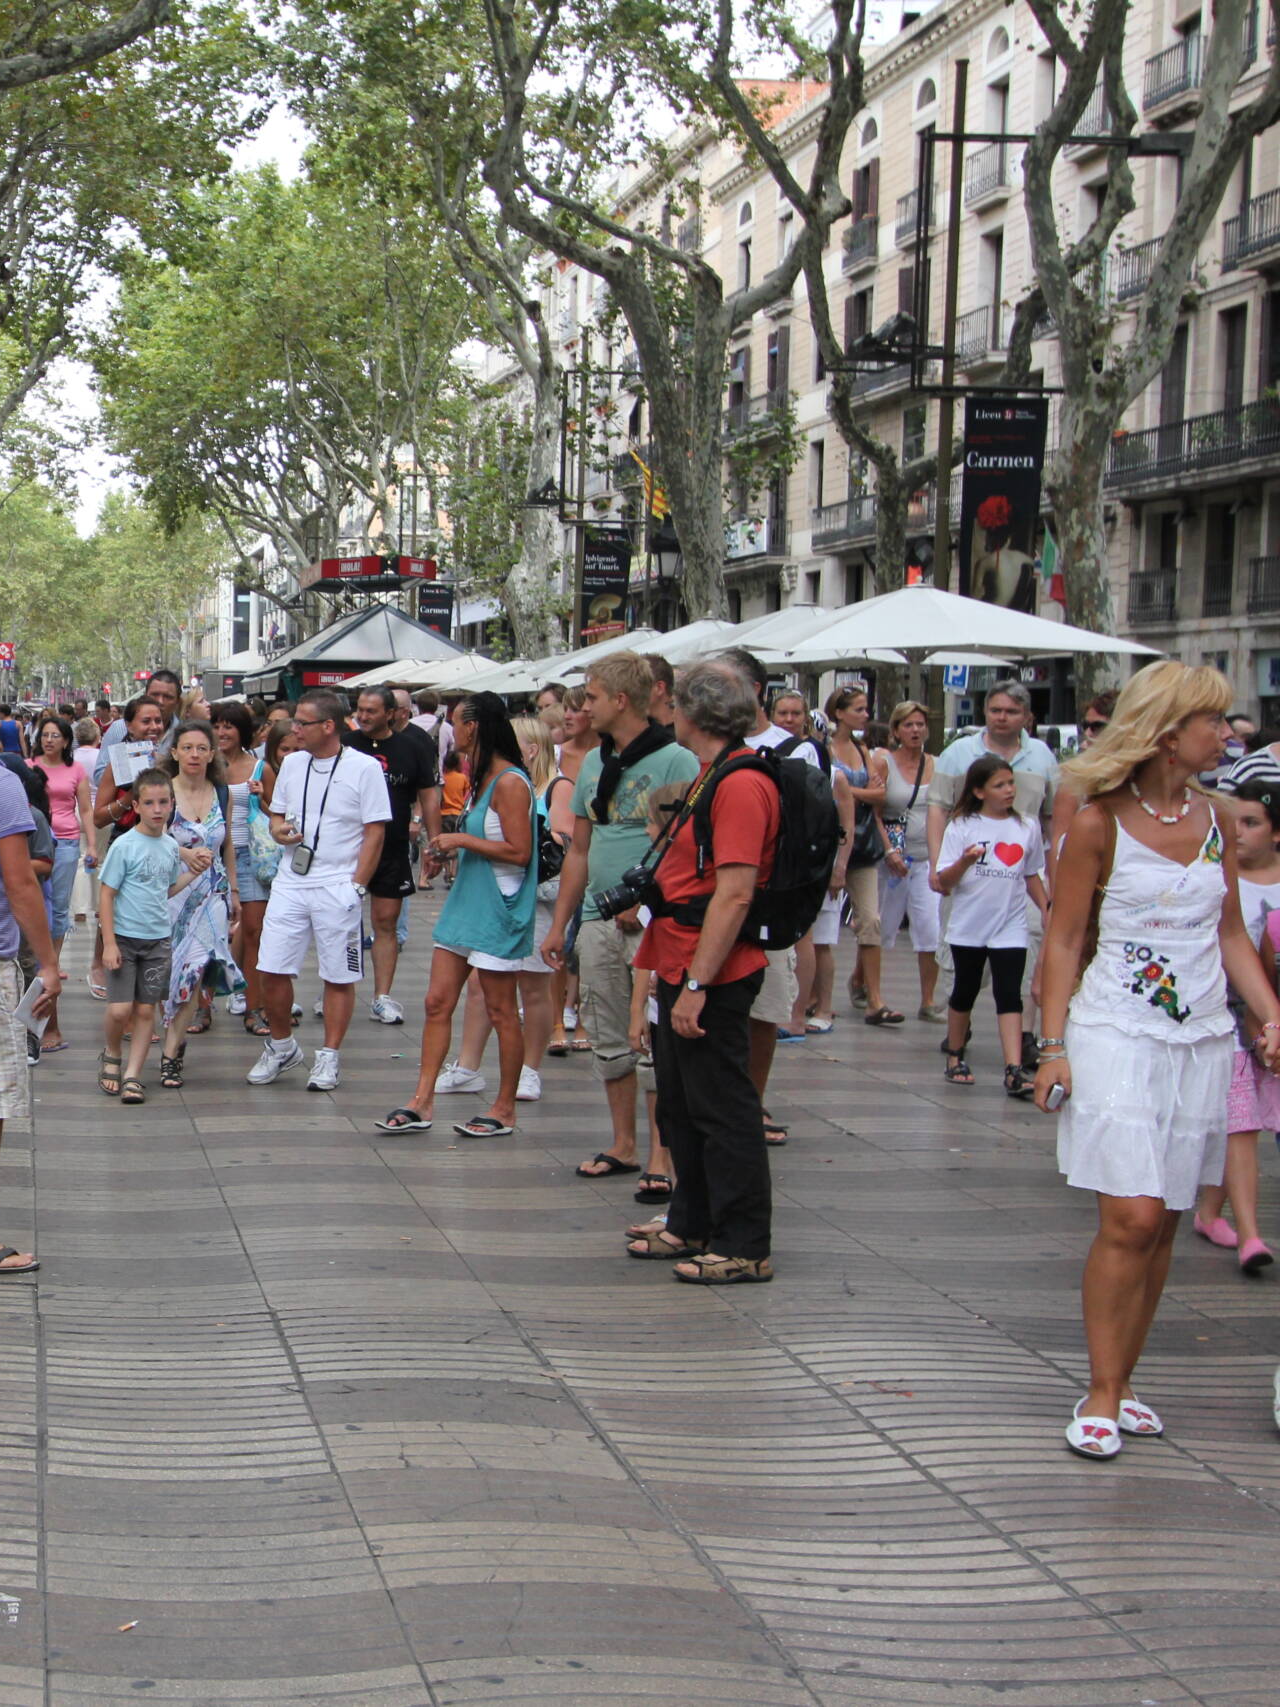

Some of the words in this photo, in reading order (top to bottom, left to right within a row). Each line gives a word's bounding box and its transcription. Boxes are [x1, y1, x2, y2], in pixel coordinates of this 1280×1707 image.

[975, 408, 1002, 420] Liceu
[966, 450, 1034, 468] Carmen
[419, 605, 449, 615] Carmen
